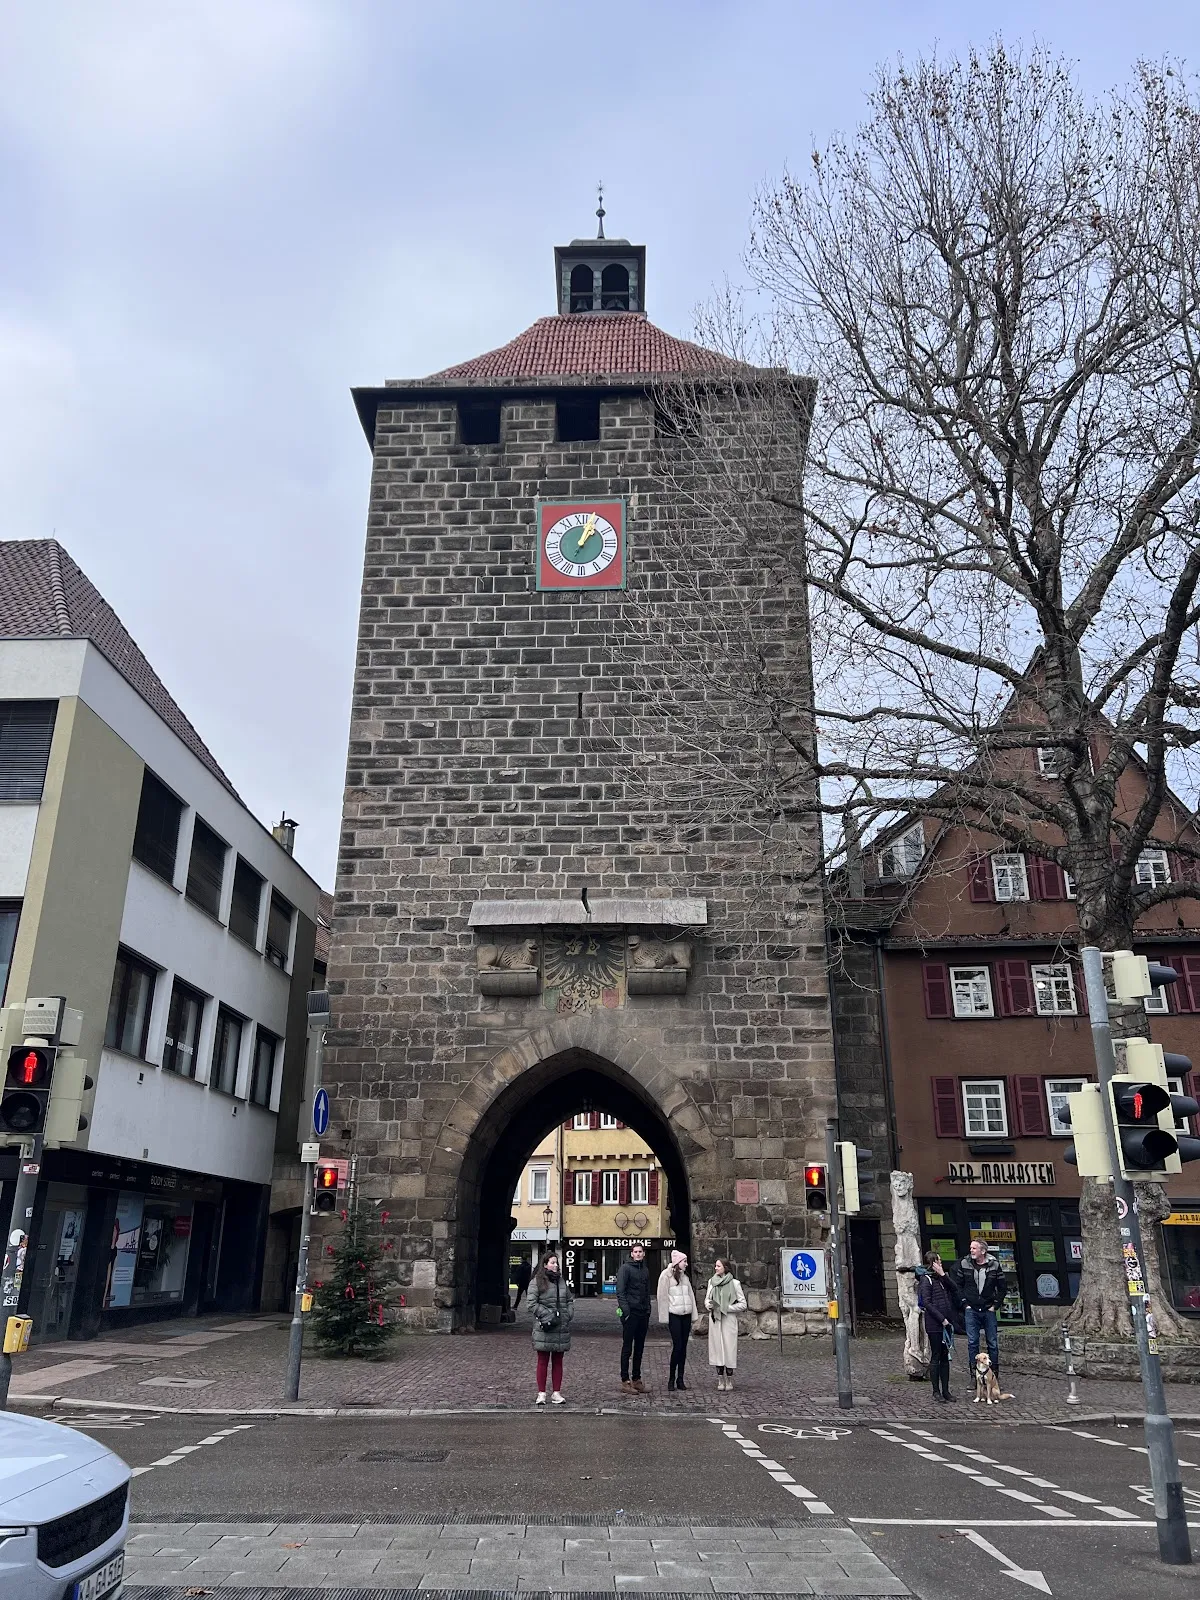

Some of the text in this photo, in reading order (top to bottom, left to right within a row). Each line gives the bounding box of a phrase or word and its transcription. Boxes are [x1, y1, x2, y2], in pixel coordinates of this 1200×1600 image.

[559, 518, 573, 531] XI
[604, 538, 617, 548] III
[949, 1162, 1055, 1184] DER MALKASTEN
[565, 1250, 575, 1288] OPTIK
[793, 1283, 816, 1292] ZONE
